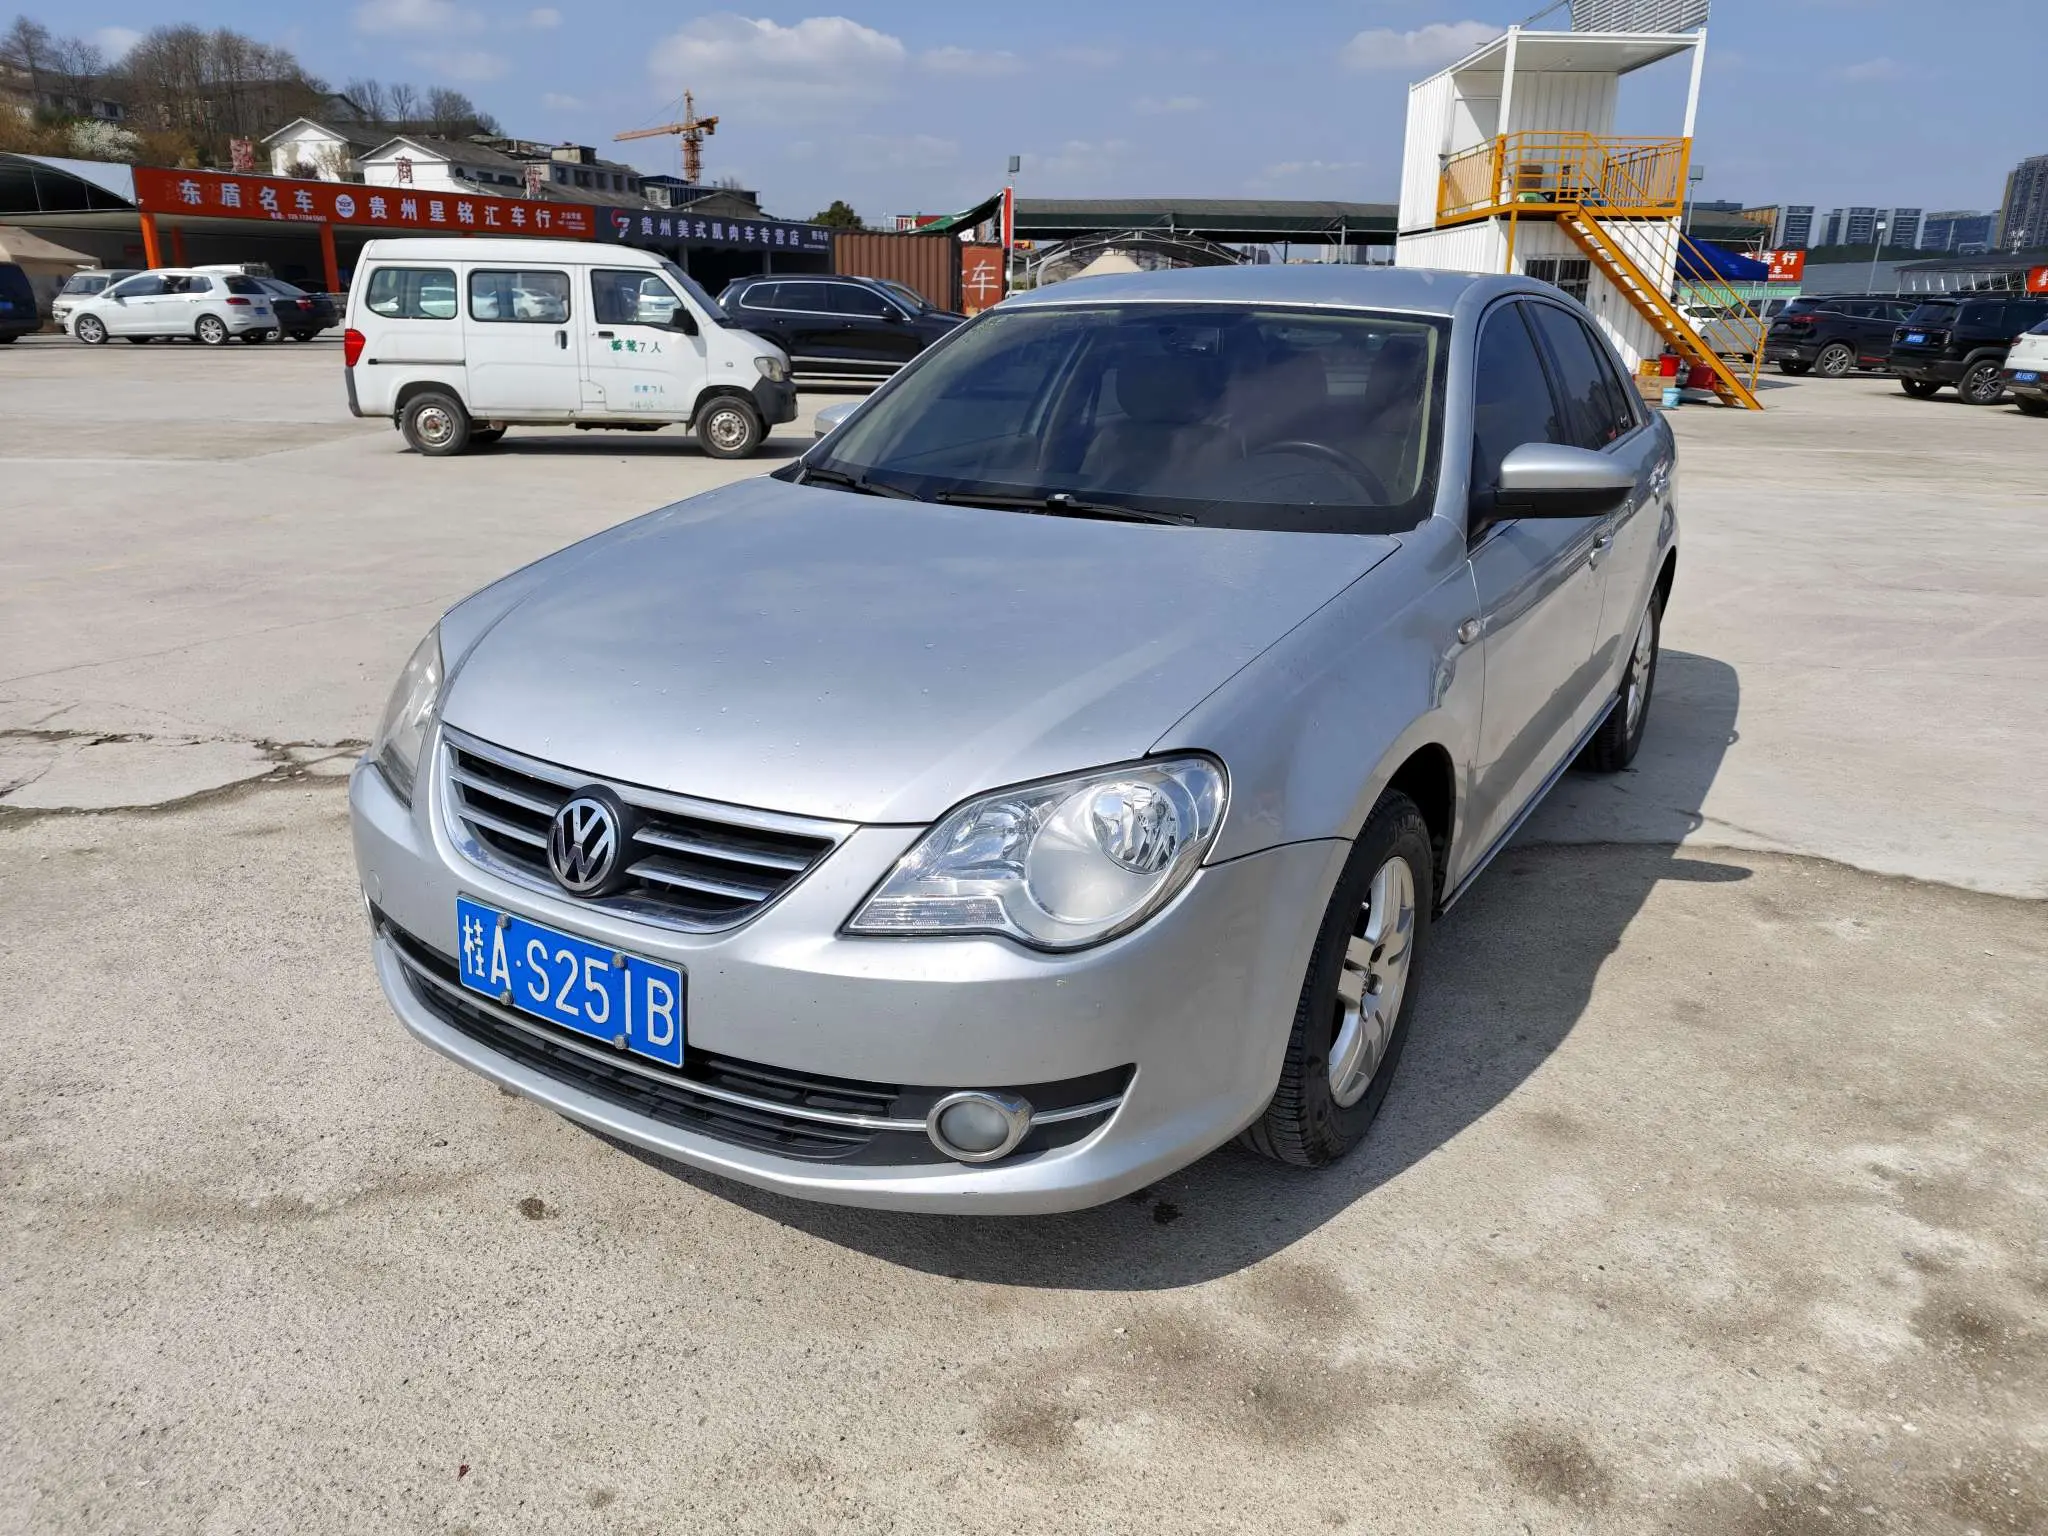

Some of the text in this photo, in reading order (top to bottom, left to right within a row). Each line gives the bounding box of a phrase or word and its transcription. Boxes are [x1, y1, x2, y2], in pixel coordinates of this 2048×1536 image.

[178, 178, 313, 213] 东盾名车
[369, 195, 551, 229] 贵州星铭汇车行
[640, 216, 799, 246] 贵州美式肌肉车专营店
[961, 260, 999, 300] 车
[550, 799, 616, 892] VW
